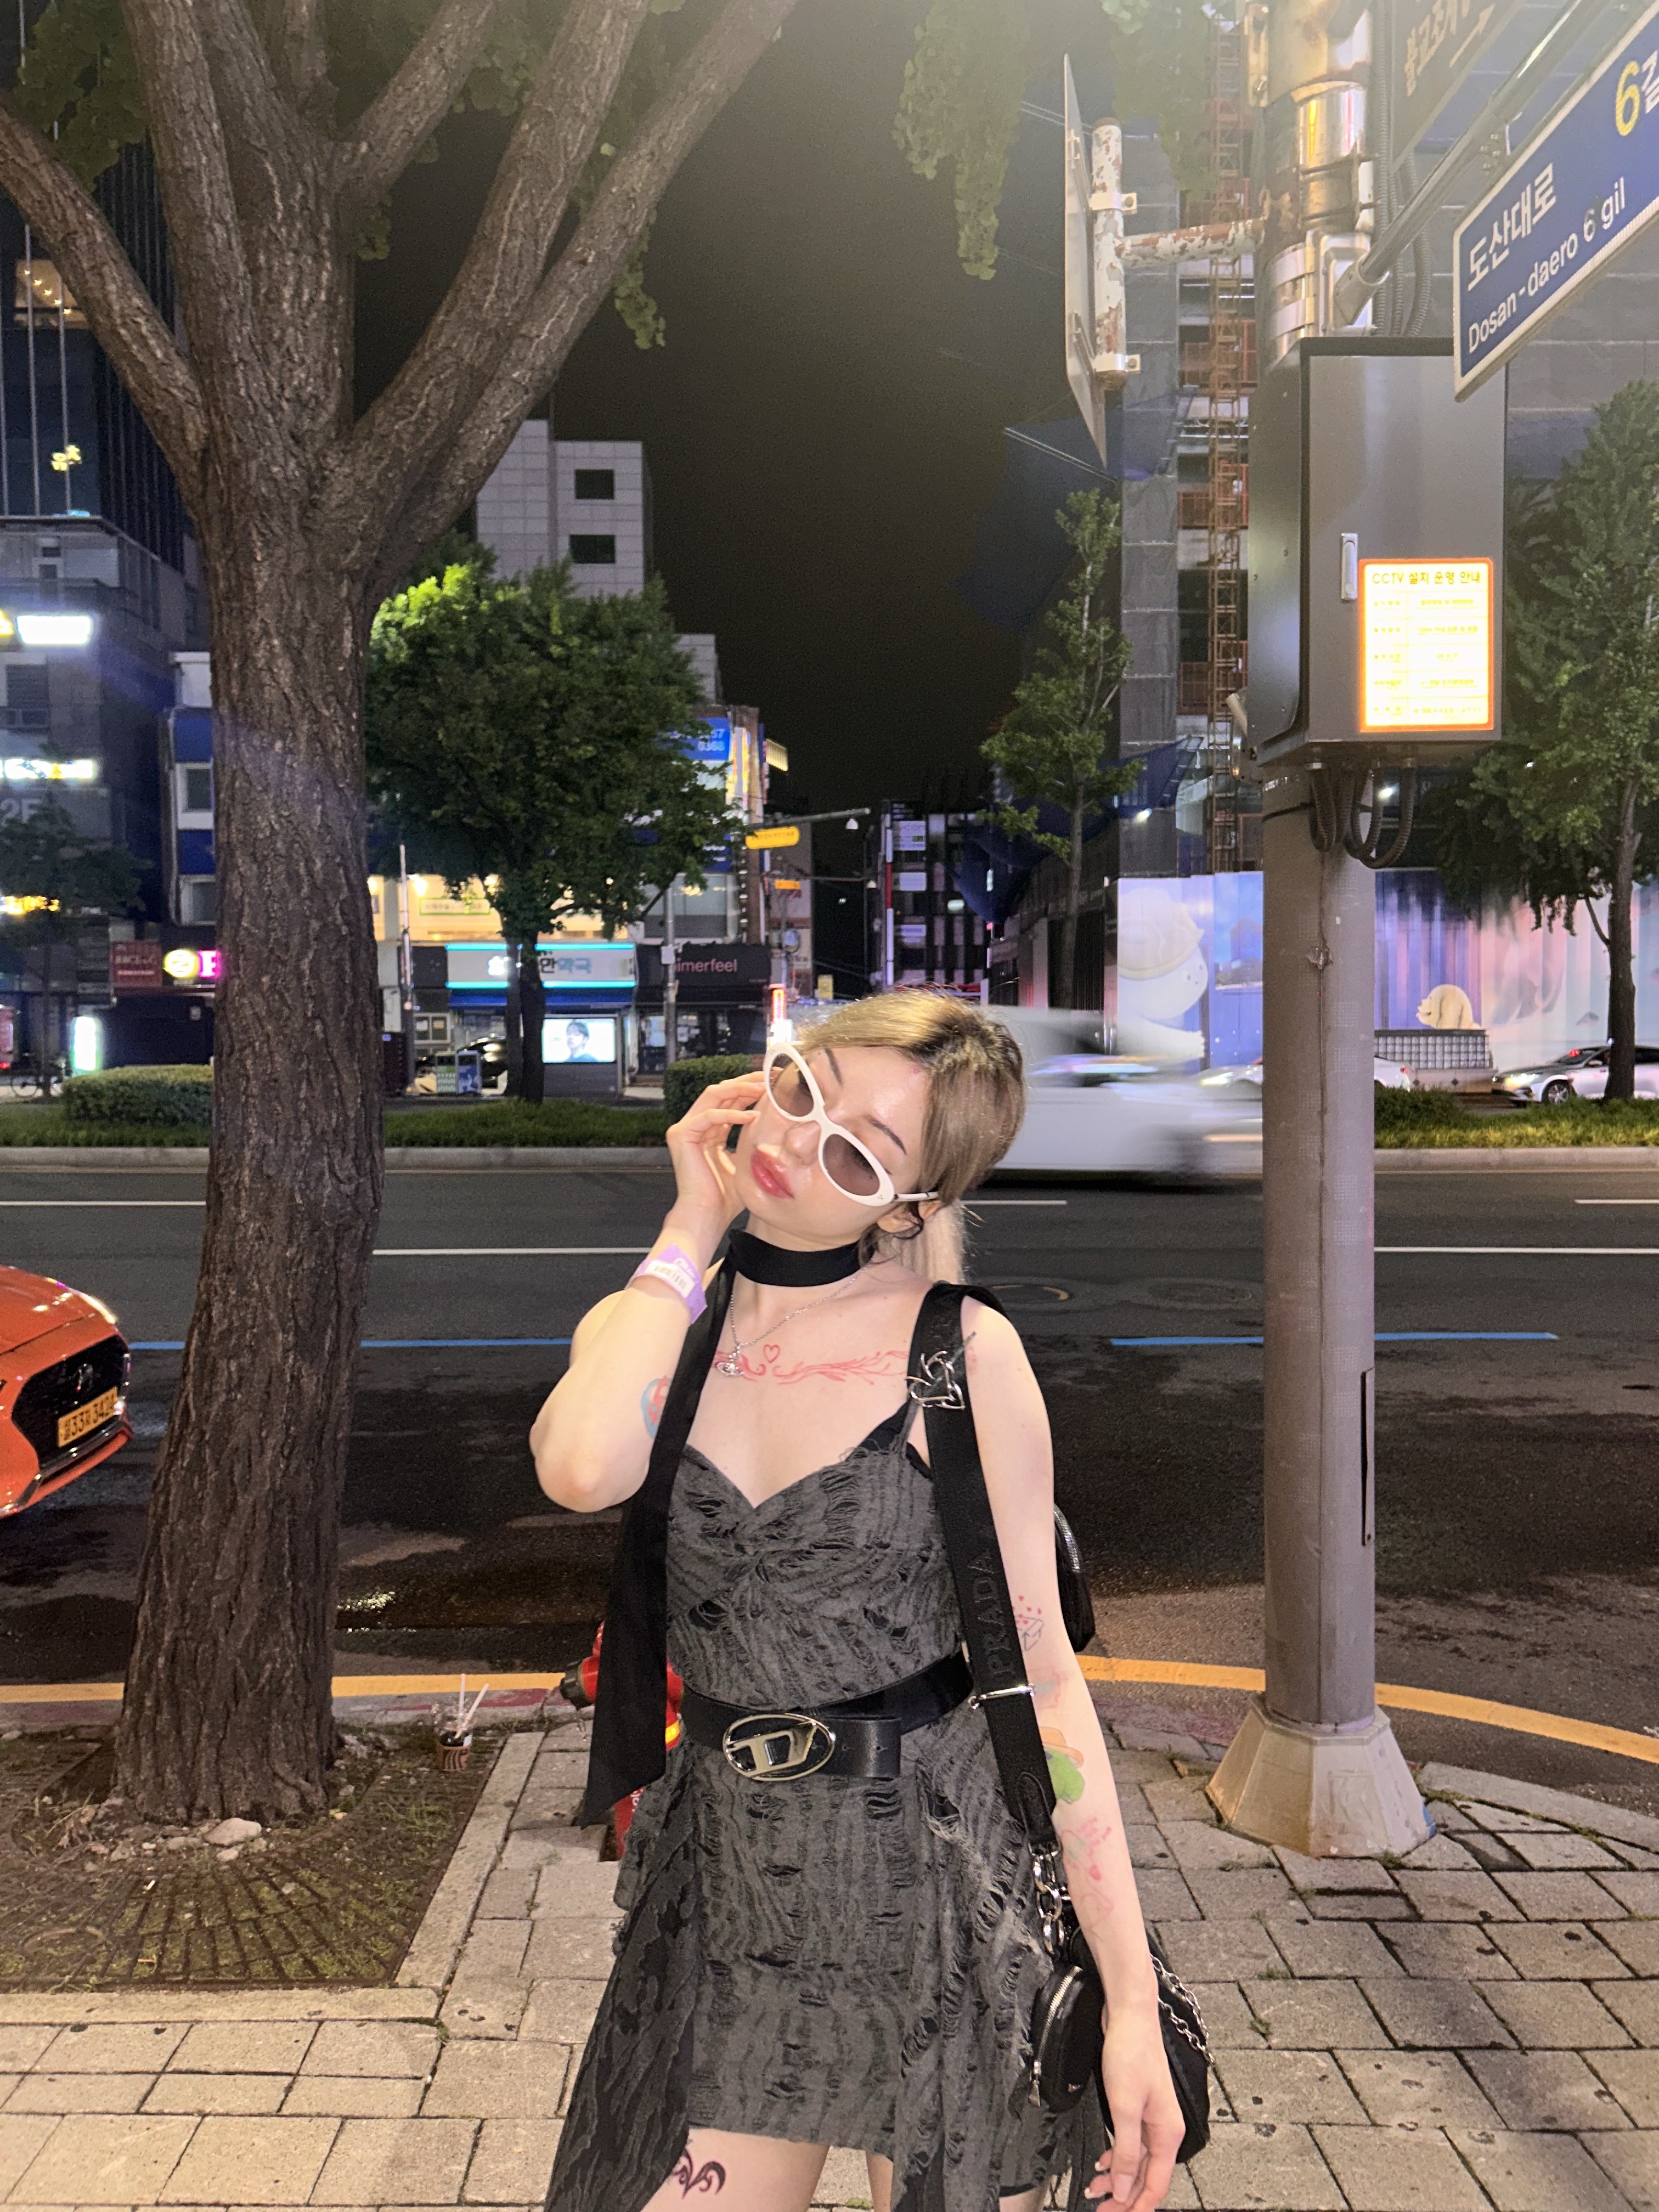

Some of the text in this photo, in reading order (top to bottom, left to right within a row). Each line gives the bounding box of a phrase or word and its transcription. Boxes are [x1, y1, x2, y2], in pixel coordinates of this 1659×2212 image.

[1468, 162, 1557, 291] 도산대로
[1583, 207, 1596, 242] 6
[1601, 176, 1626, 230] gil
[1372, 571, 1480, 585] CCTV 설치 운영 안내
[674, 957, 738, 973] imerfeel
[966, 1549, 1017, 1678] PRADA
